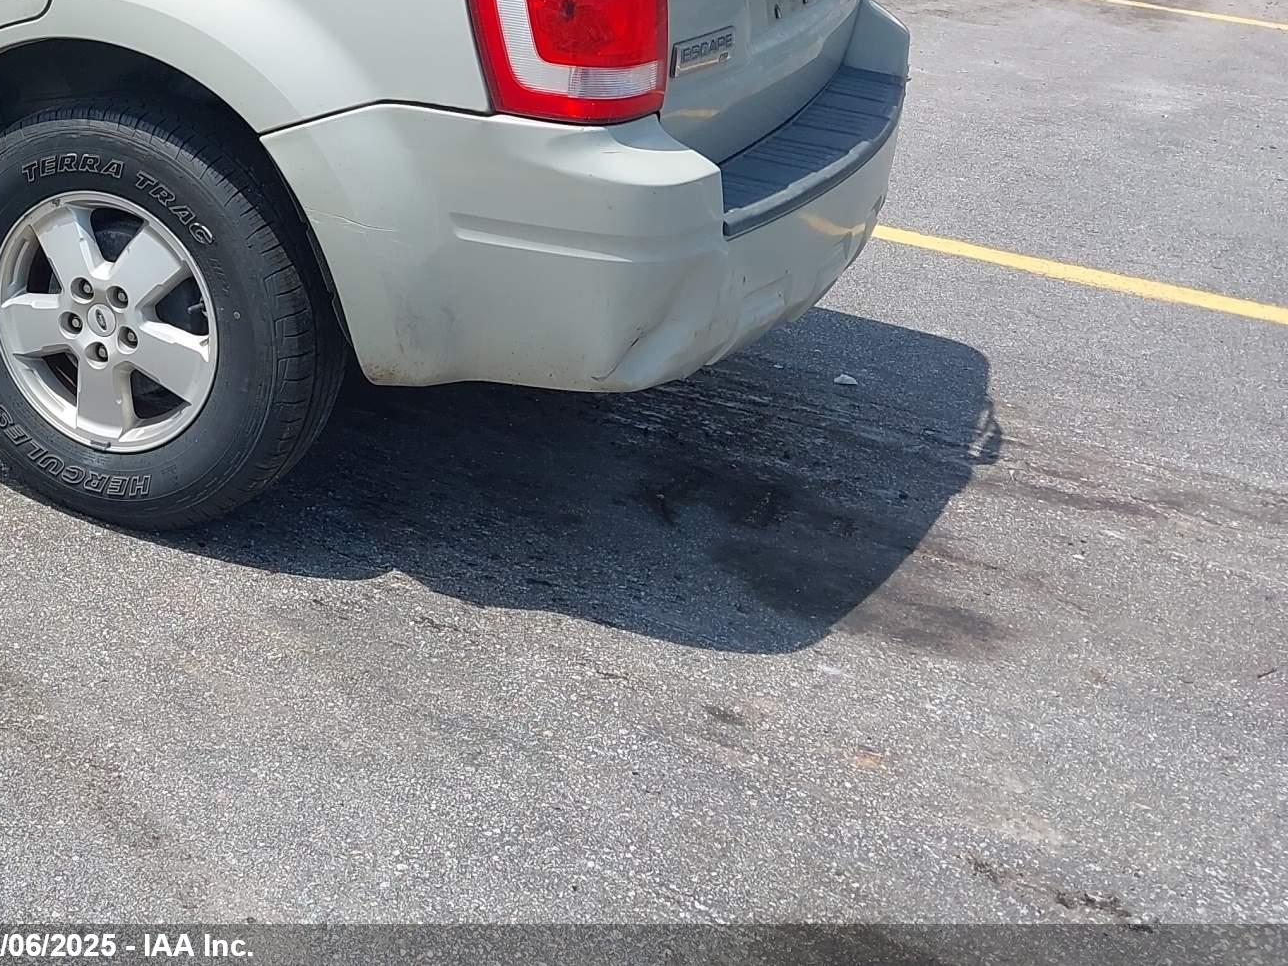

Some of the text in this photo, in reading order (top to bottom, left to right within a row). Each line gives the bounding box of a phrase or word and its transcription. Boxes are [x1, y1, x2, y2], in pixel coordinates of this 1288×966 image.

[680, 33, 733, 63] ESCAPE
[22, 153, 214, 245] TERRA TRAC
